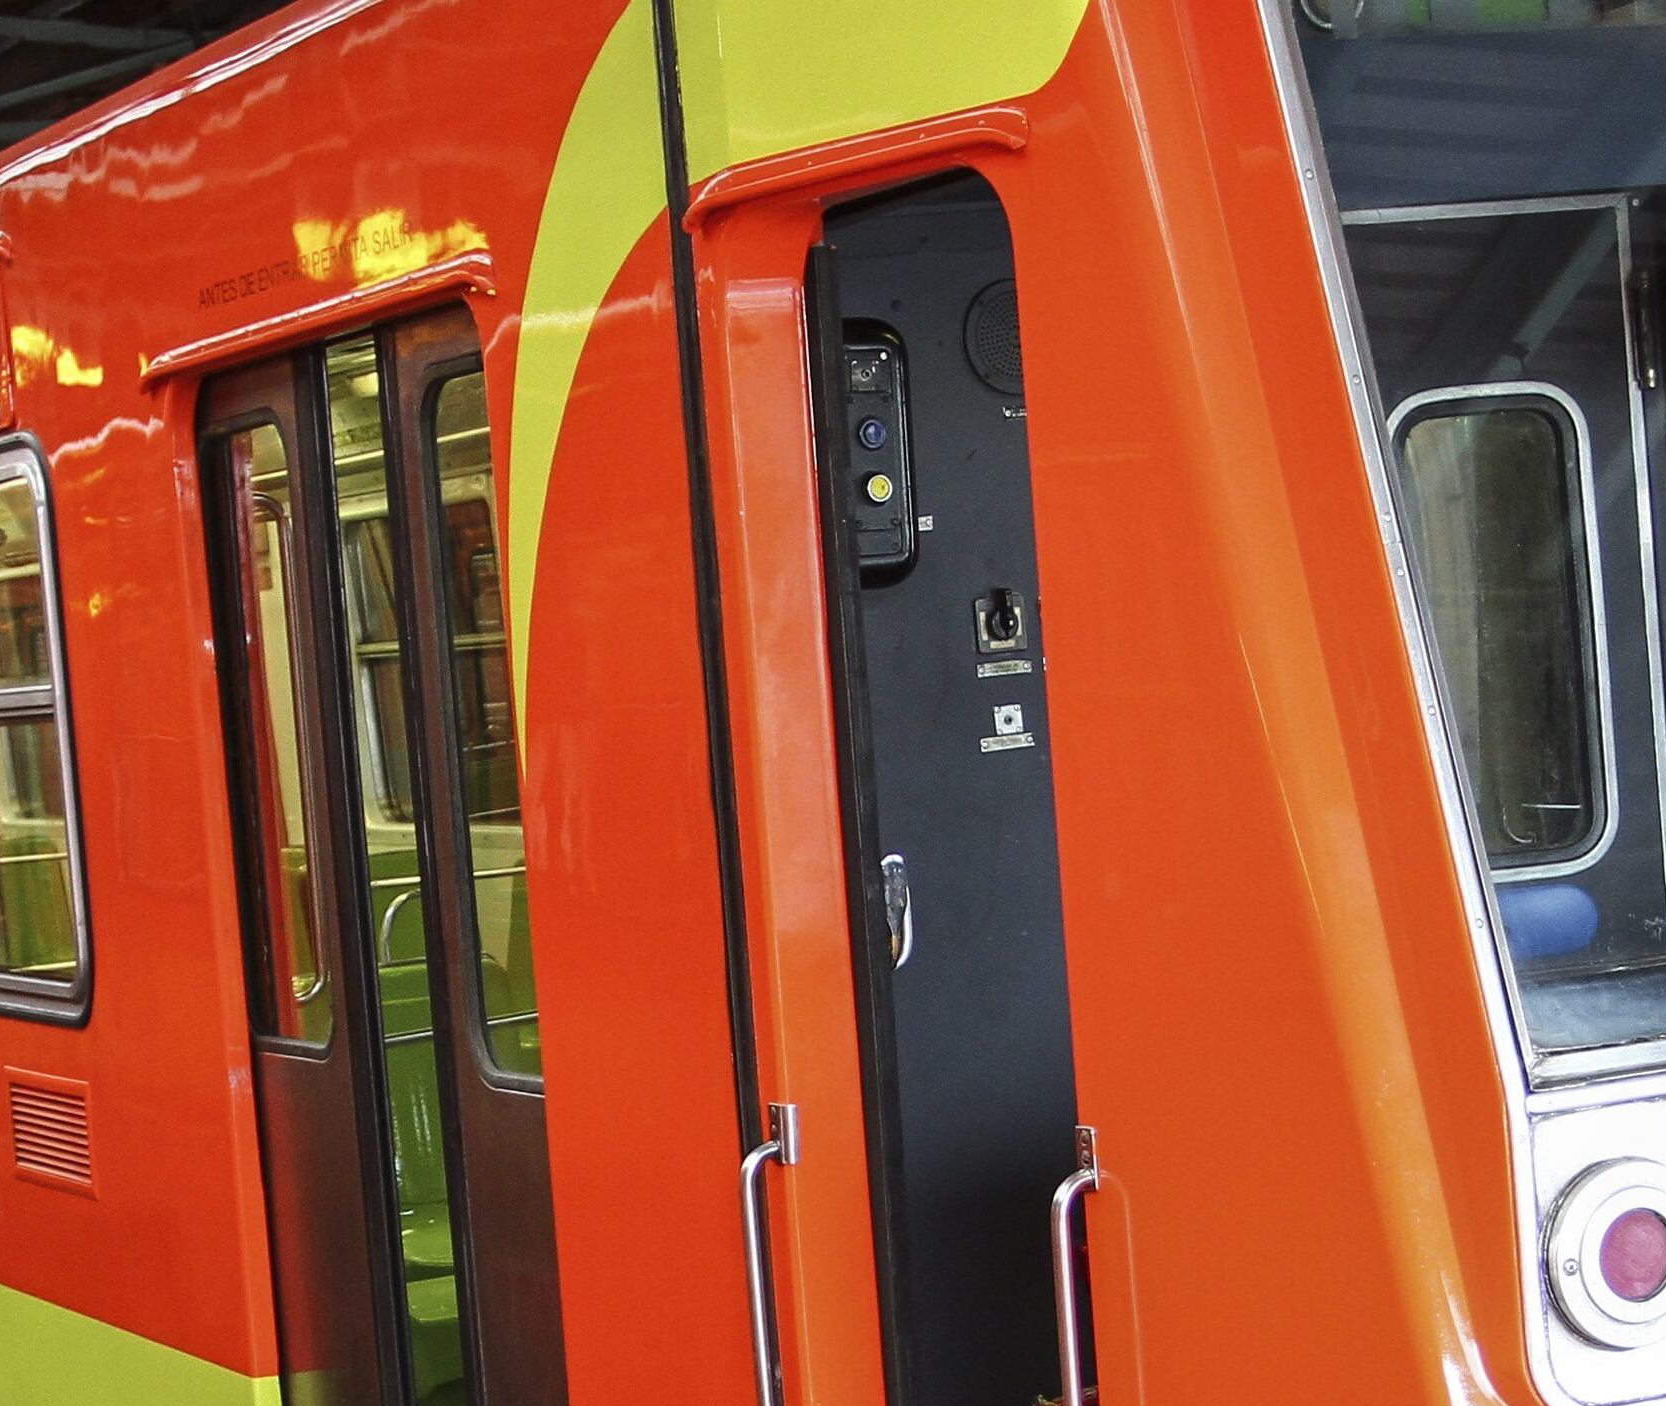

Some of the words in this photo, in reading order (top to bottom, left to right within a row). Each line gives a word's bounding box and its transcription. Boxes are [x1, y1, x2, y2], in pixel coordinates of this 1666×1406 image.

[199, 276, 237, 307] ANTES
[240, 271, 255, 296] DE
[372, 222, 413, 255] SALIR
